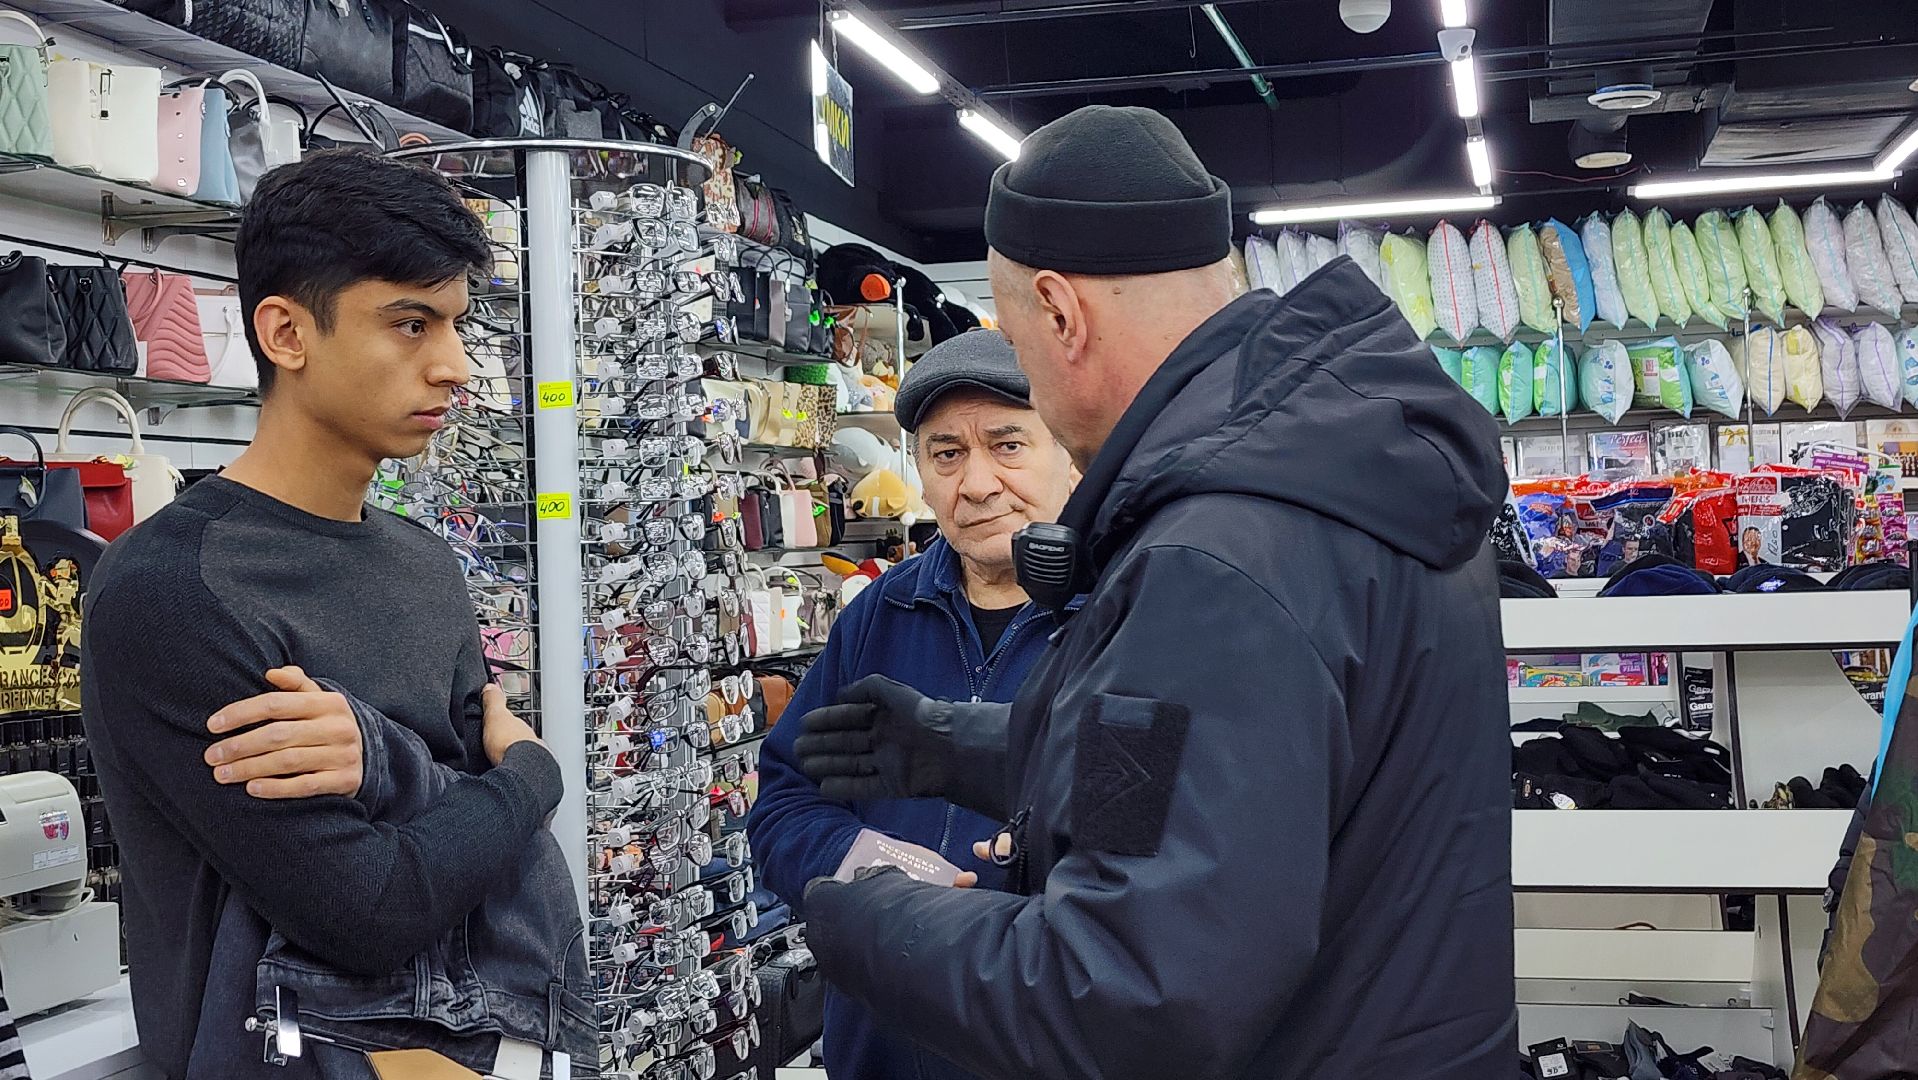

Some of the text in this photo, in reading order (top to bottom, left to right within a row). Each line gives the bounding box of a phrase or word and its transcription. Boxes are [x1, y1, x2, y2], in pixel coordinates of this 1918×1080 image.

[542, 391, 566, 404] 400
[1610, 433, 1646, 445] Perfect
[540, 501, 566, 514] 400
